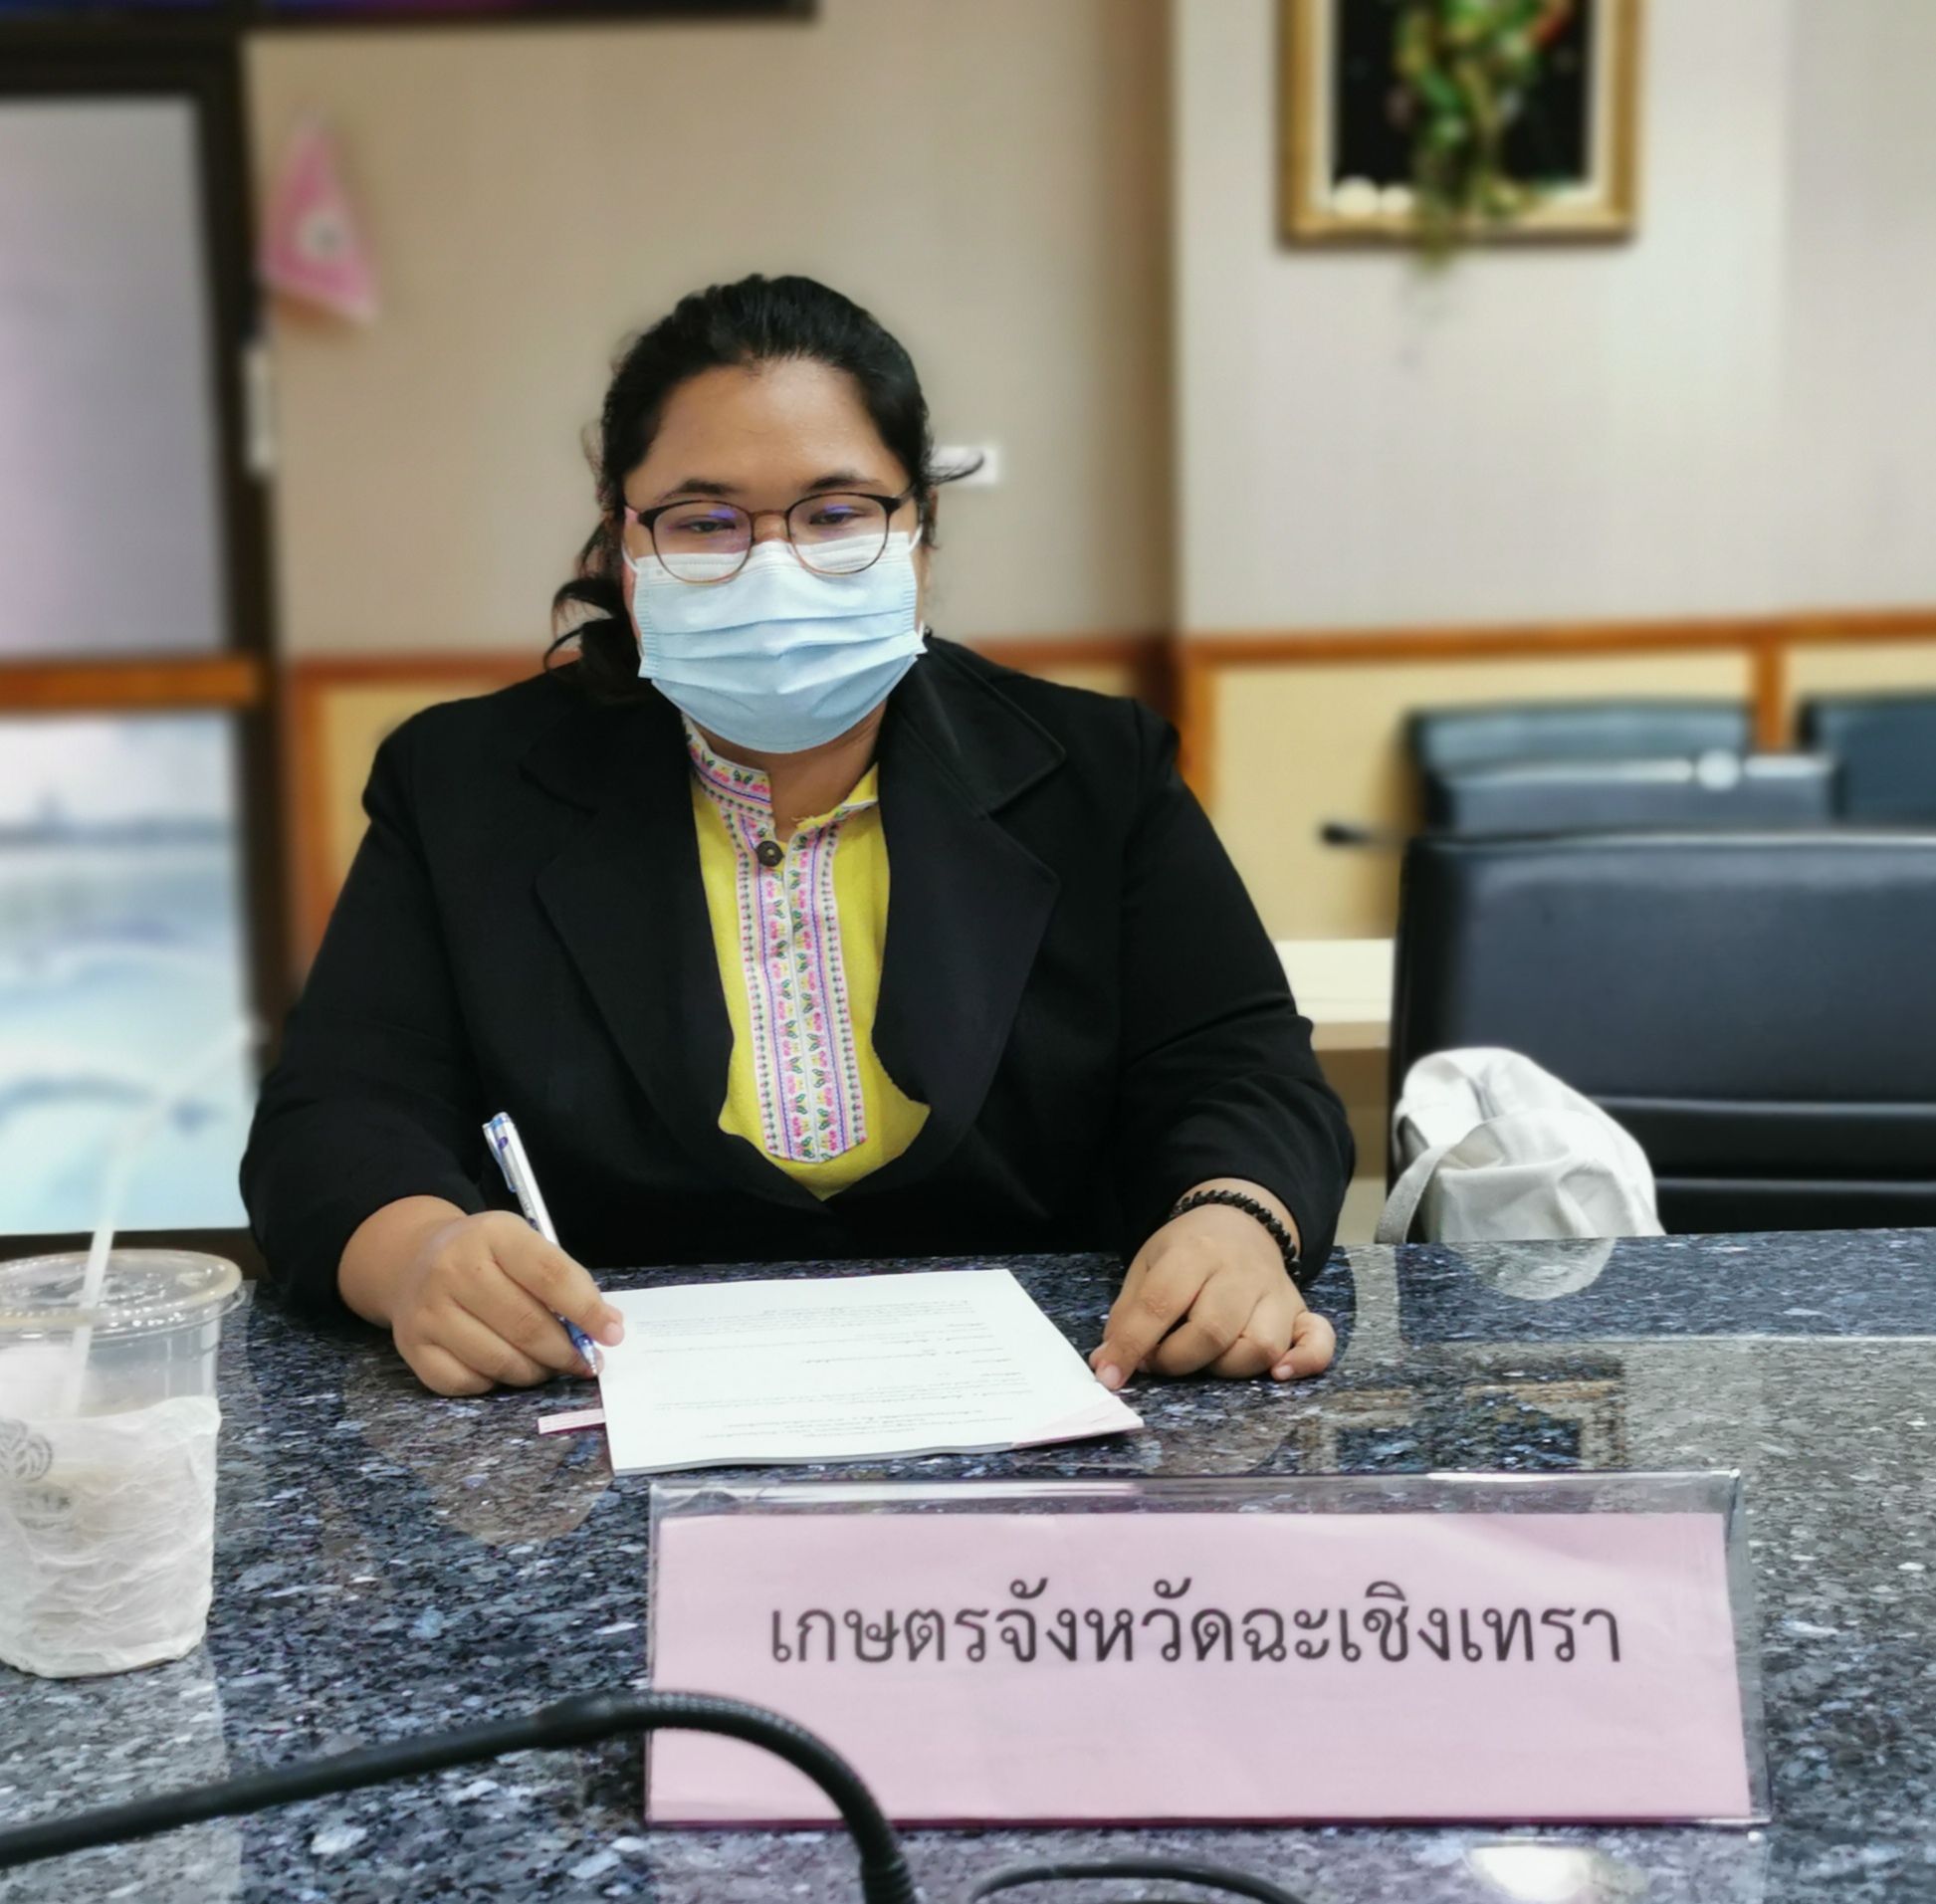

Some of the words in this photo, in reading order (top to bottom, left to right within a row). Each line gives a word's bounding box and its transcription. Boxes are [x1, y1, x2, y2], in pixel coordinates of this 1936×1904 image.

[771, 1578, 1620, 1663] เกษตรจังหวัดฉะเชิงเทรา
